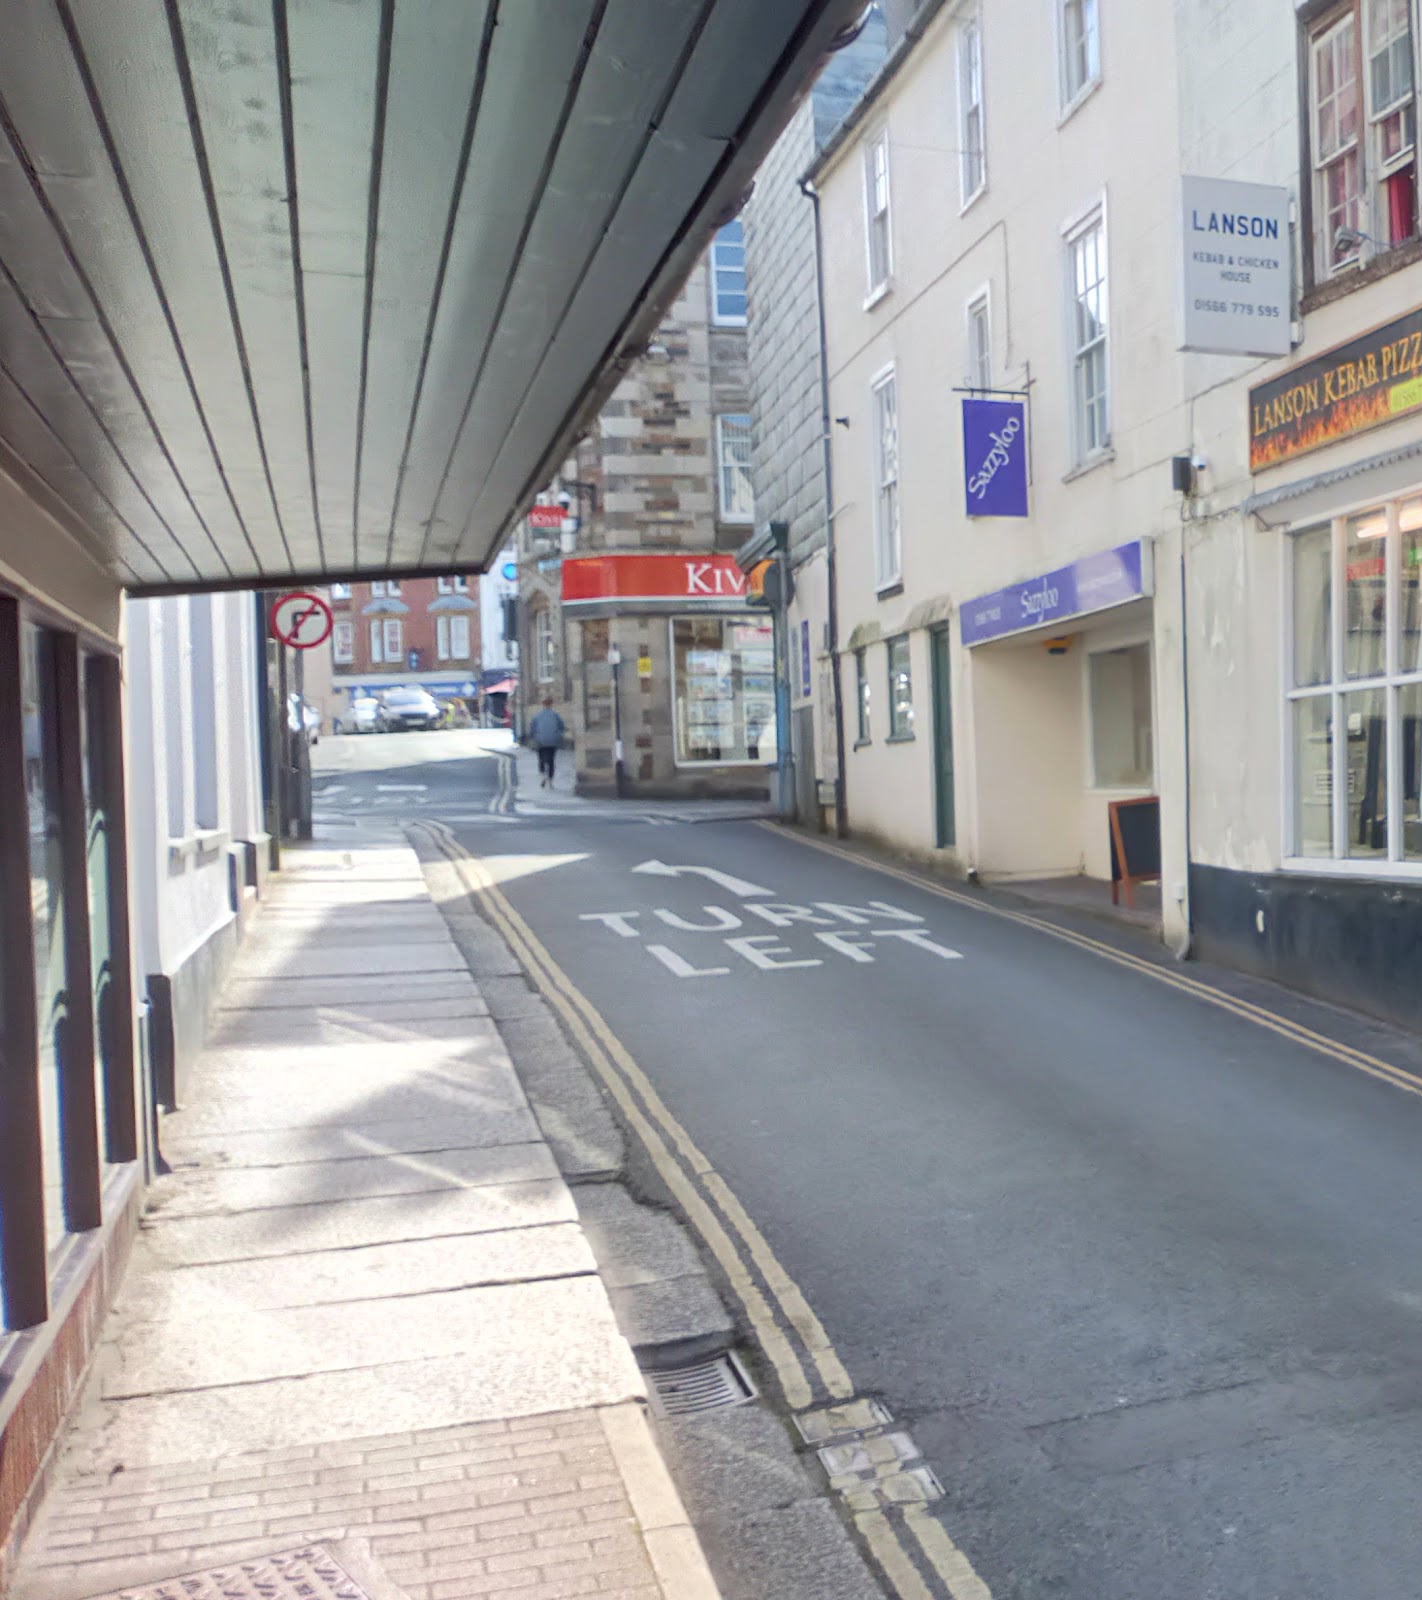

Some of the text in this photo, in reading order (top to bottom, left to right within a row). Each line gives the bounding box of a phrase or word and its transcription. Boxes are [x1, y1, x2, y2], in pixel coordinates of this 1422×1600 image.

[1192, 210, 1279, 240] LANSON
[1193, 250, 1279, 269] KEBAB & CHICKEN
[1221, 271, 1252, 284] HOUSE
[1232, 302, 1254, 316] 779
[1258, 305, 1279, 318] 595
[1254, 377, 1319, 436] LANSON
[968, 416, 1021, 500] Sazzyloo
[685, 562, 748, 594] KIV
[578, 901, 926, 938] TURN
[645, 928, 965, 978] LEFT
